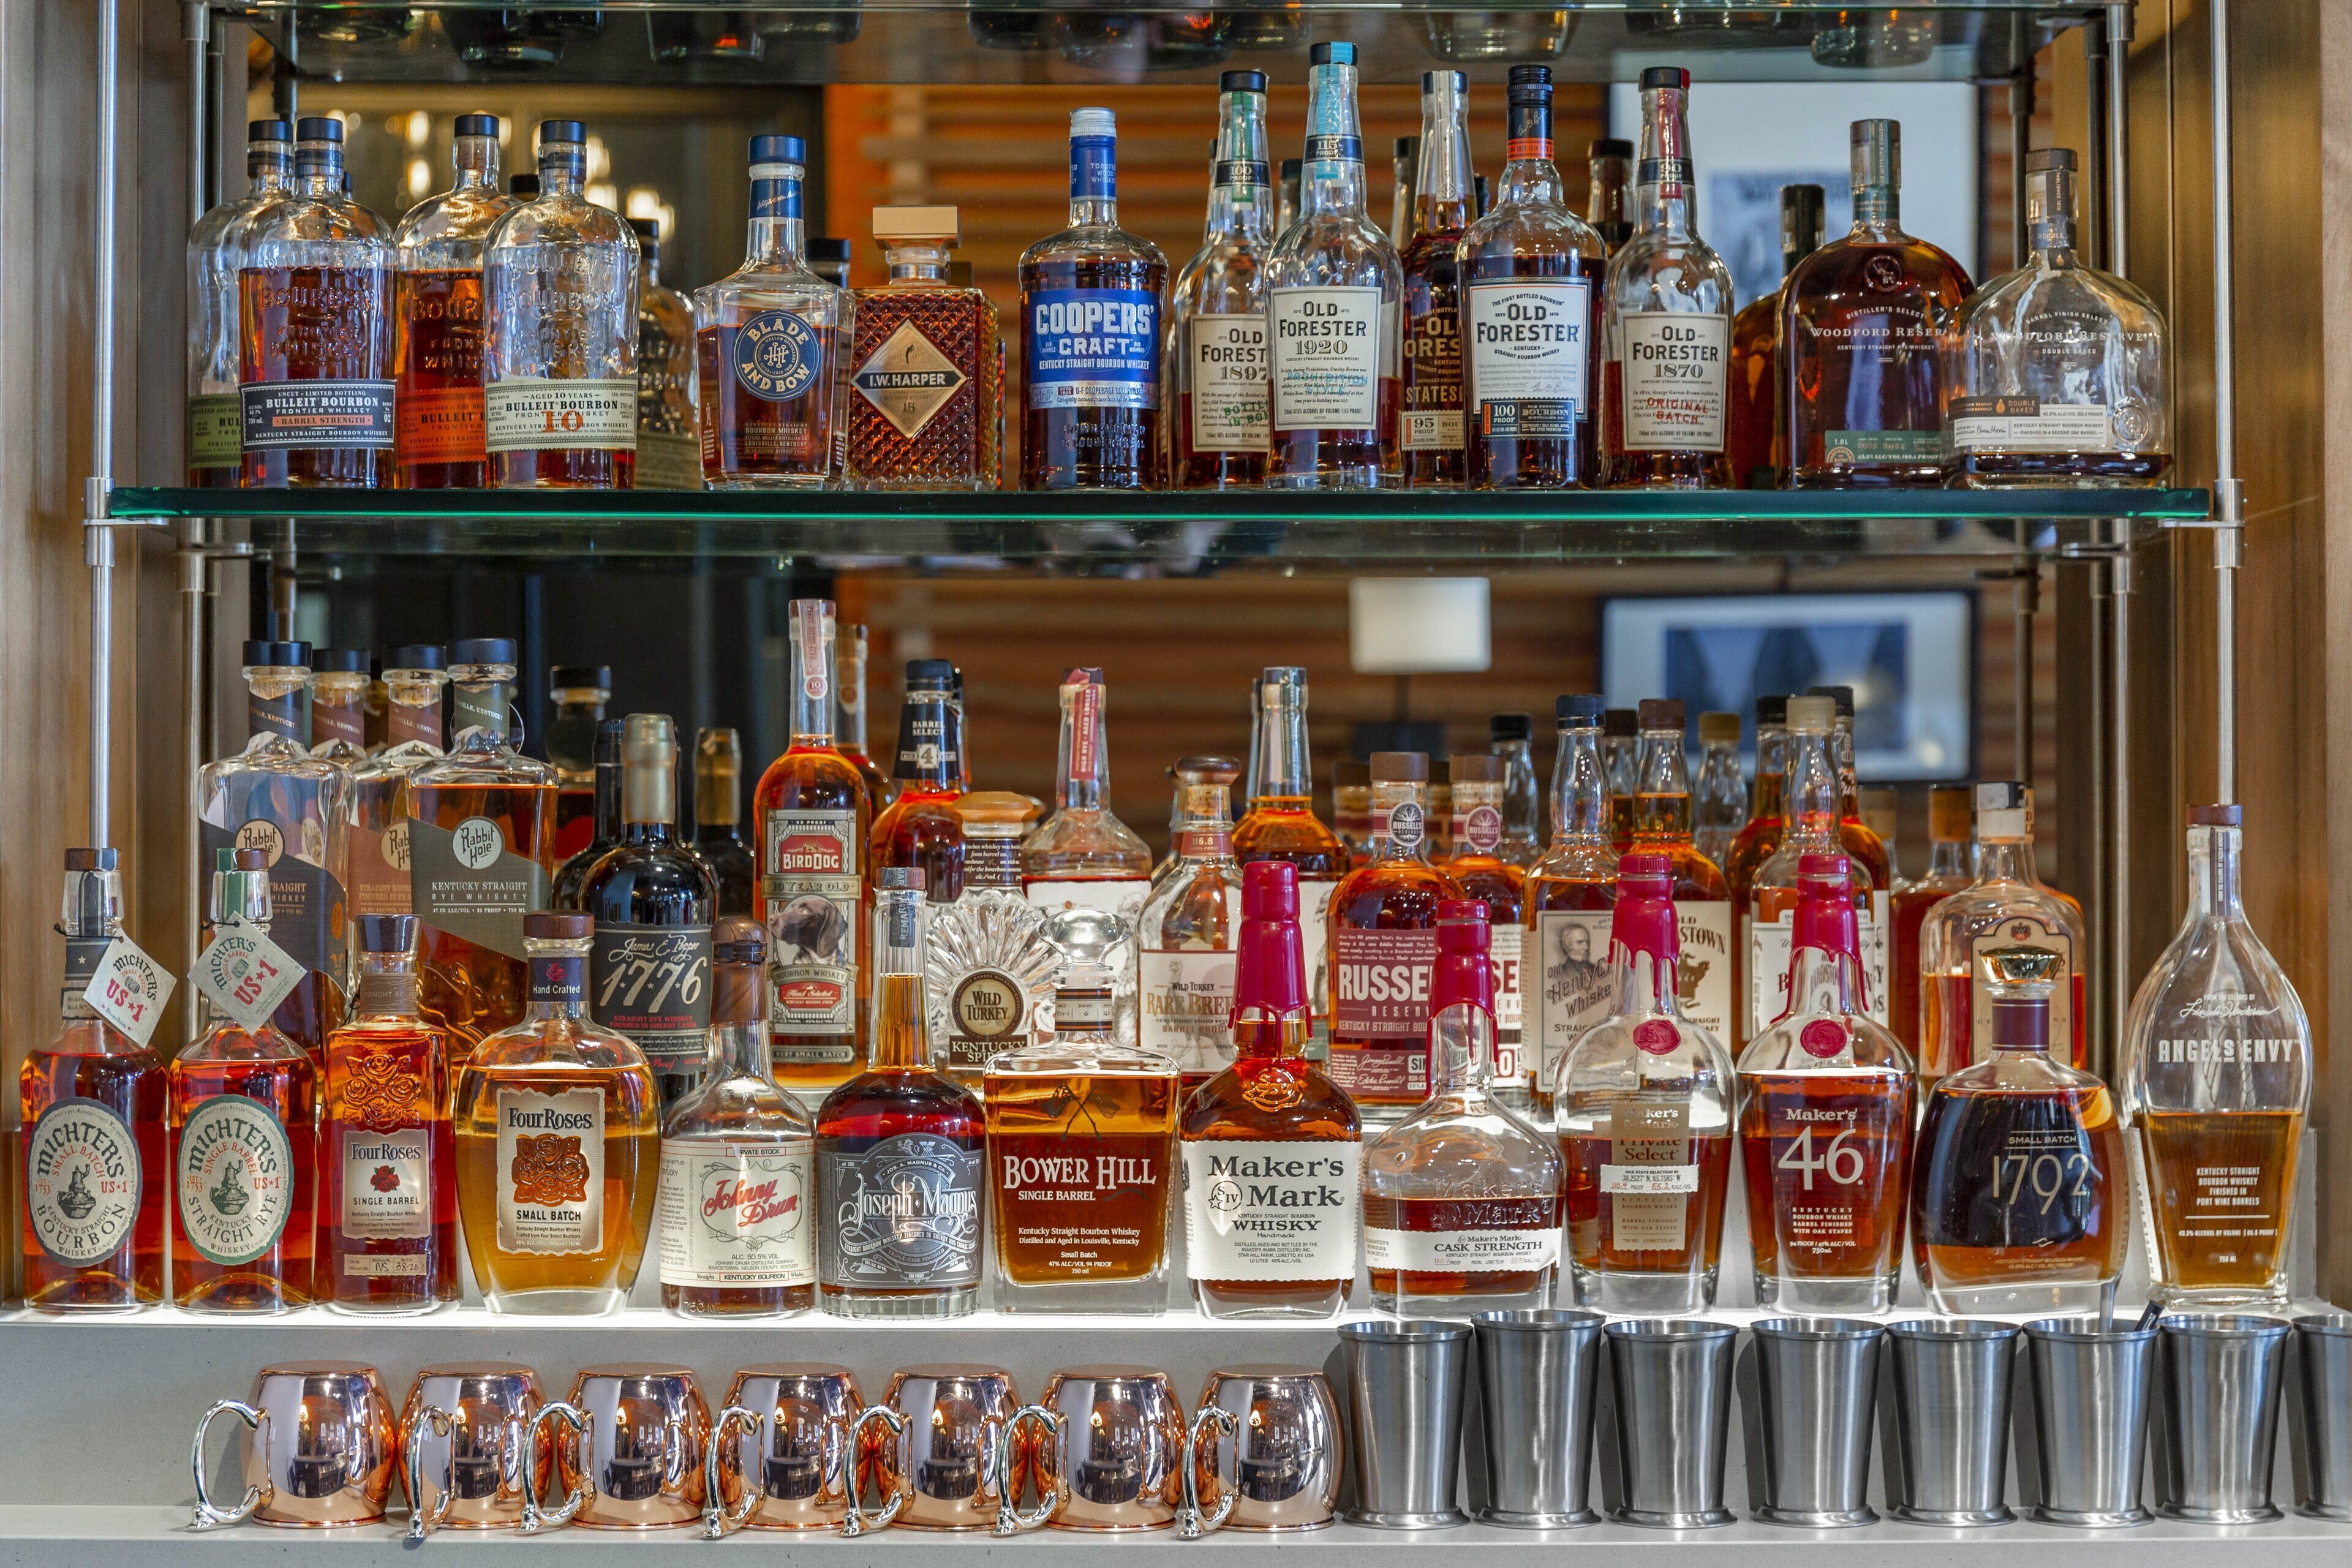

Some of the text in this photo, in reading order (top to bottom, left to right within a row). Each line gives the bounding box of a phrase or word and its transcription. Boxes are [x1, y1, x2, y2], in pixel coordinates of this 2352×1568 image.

[1317, 140, 1337, 150] 115
[1230, 165, 1251, 175] 100
[1502, 295, 1515, 304] FIRST
[1539, 295, 1562, 306] BOURBON
[1303, 301, 1338, 317] OLD
[1507, 304, 1546, 320] OLD
[1846, 307, 1925, 319] DISTILLER'S SELECT
[747, 318, 810, 345] BLADE
[1280, 319, 1366, 337] FORESTER
[1477, 322, 1578, 343] FORESTER
[1662, 326, 1695, 341] OLD
[1811, 328, 1890, 337] WOODFORD
[1229, 328, 1263, 344] OLD
[2080, 331, 2144, 341] RESERVE
[1059, 338, 1130, 355] CRAFT
[1200, 344, 1265, 363] FOREST
[1295, 339, 1348, 355] 1920
[1632, 342, 1718, 361] FORESTER
[1039, 358, 1150, 370] KENTUCKY STRAIGHT BOURBON WHISKEY
[1654, 364, 1703, 378] 1870
[742, 363, 810, 392] AND BOW
[892, 374, 946, 386] HARPER
[1221, 366, 1267, 380] 1897
[266, 398, 379, 409] BULLEIT BOURBON
[506, 401, 617, 412] BULLEIT BOURBON
[1493, 405, 1515, 417] 100
[1646, 398, 1708, 413] ORIGINAL
[383, 413, 391, 423] 02
[421, 412, 475, 424] BULLEIT
[1414, 418, 1434, 428] 95
[1657, 411, 1698, 423] BATCH
[921, 748, 933, 763] 4
[1393, 821, 1422, 830] RUSSELL'S
[243, 825, 277, 849] Rabbit
[461, 824, 497, 850] Rabbit
[469, 843, 492, 869] Hole
[432, 881, 527, 891] KENTUCKY STRAIGHT
[772, 882, 849, 891] 10 YEAR OLD
[608, 937, 654, 962] James
[668, 934, 700, 962] Pepper
[211, 937, 257, 990] MICHTER'S
[113, 954, 156, 1001] MICHTER'S
[776, 968, 845, 979] BOURBON WHISKEY
[533, 984, 580, 993] Hand Crafted
[600, 957, 707, 1013] 1776
[1545, 965, 1597, 1005] Henry
[972, 991, 1001, 1006] WILD
[1147, 992, 1232, 1014] RARE BREE
[1566, 984, 1611, 1019] Whiske
[105, 1008, 127, 1029] Bourbon
[965, 1006, 1008, 1020] TURKEY
[1340, 1020, 1410, 1032] KENTUCKY STRAIGHT
[952, 1042, 1025, 1052] KENTUCKY
[2243, 1039, 2293, 1063] ENVY
[1786, 1109, 1857, 1121] Maker's
[37, 1121, 124, 1178] MICHTER'S
[189, 1117, 276, 1174] MICHTER'S
[52, 1145, 105, 1178] SMALL BATCH
[204, 1142, 258, 1175] SINGLE BARREL
[1625, 1148, 1675, 1160] Select
[1003, 1156, 1156, 1189] BOWER HILL
[1207, 1155, 1344, 1177] Maker's
[186, 1181, 203, 1191] 1753
[1993, 1153, 2089, 1215] 1792
[704, 1178, 778, 1217] Johnny
[1019, 1191, 1096, 1200] SINGLE BARREL
[1246, 1185, 1343, 1207] Mark
[737, 1194, 797, 1227] Drum
[839, 1171, 915, 1236] Joseph
[913, 1173, 977, 1235] Magnus
[189, 1194, 277, 1243] STRAIGHT RYE
[516, 1210, 581, 1221] SMALL BATCH
[36, 1204, 126, 1249] BOURBON
[1019, 1227, 1050, 1236] Kentucky
[1051, 1228, 1079, 1237] Straight
[1112, 1228, 1140, 1237] Whiskey
[1231, 1220, 1321, 1231] WHISKY
[1475, 1242, 1542, 1251] STRENGTH
